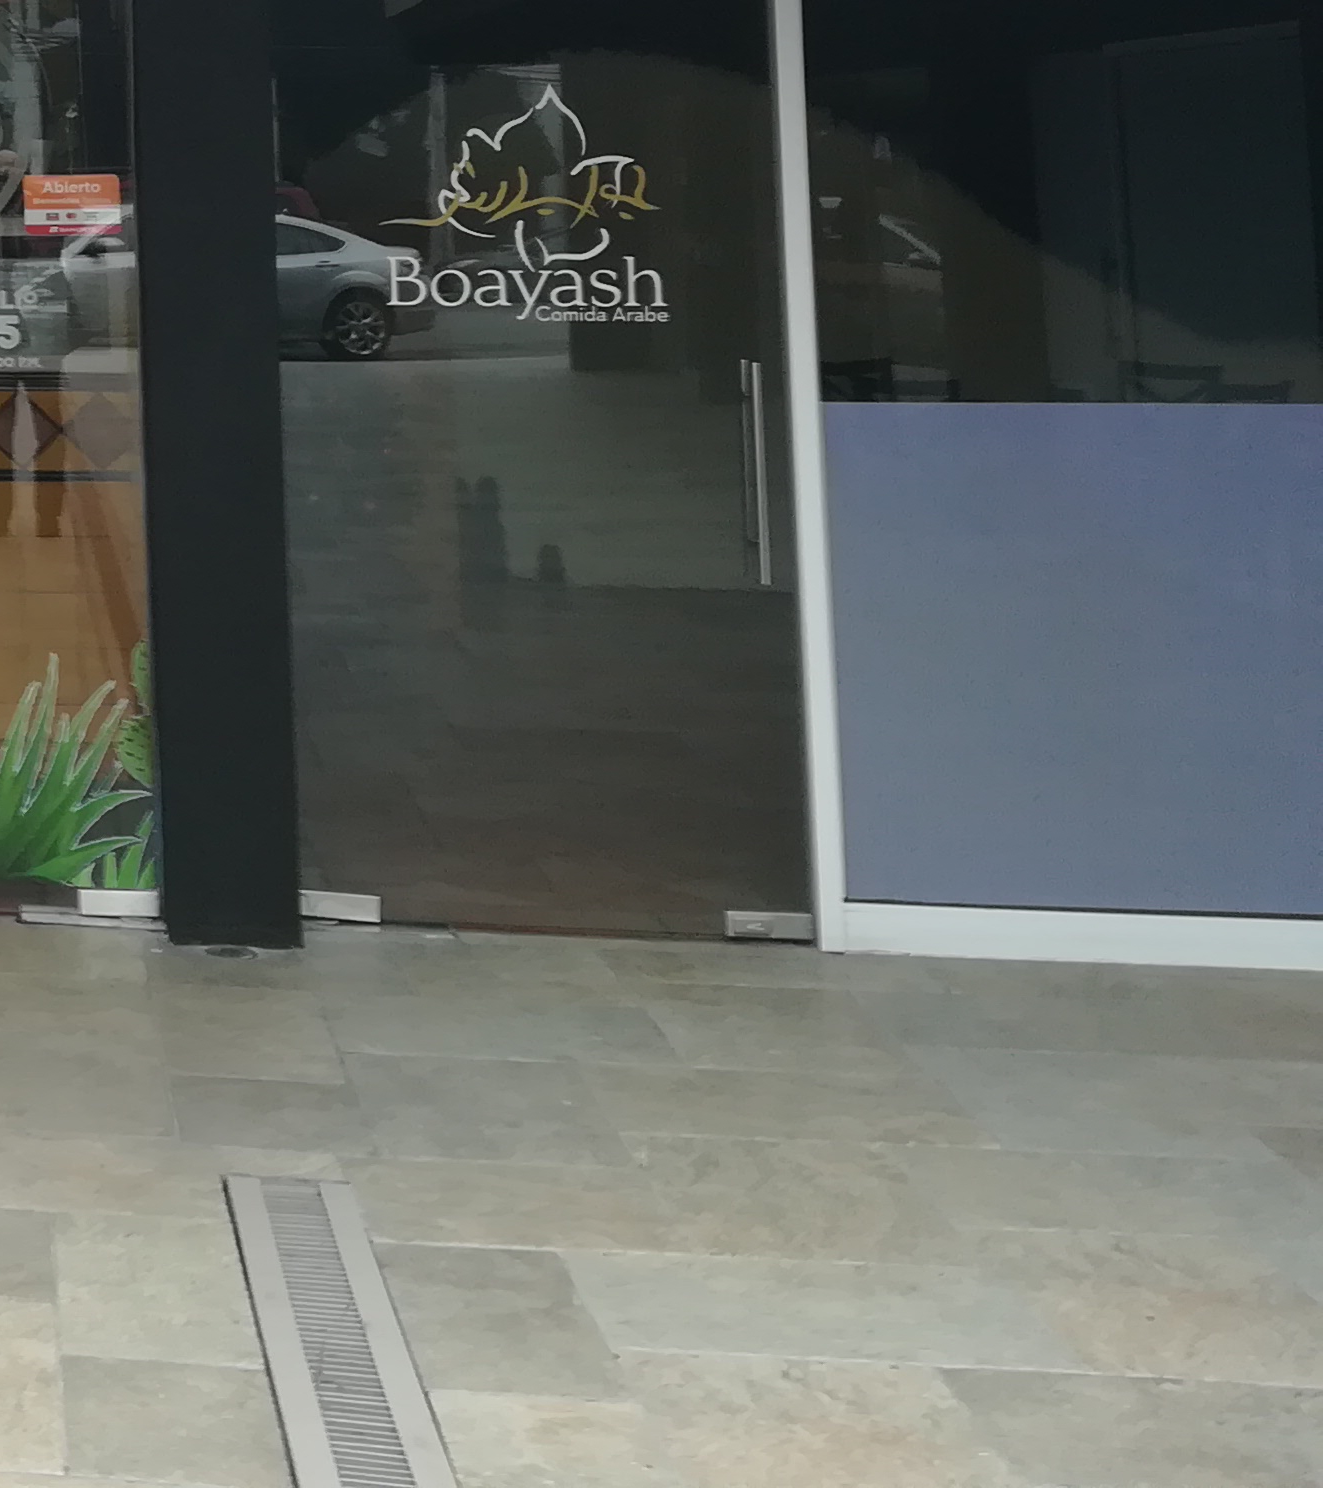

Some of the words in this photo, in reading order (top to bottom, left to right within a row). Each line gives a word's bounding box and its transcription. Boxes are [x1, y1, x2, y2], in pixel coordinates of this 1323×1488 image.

[42, 181, 102, 194] Abierto
[386, 256, 670, 320] Boayash
[535, 305, 608, 322] Comida
[613, 305, 671, 322] Arabe
